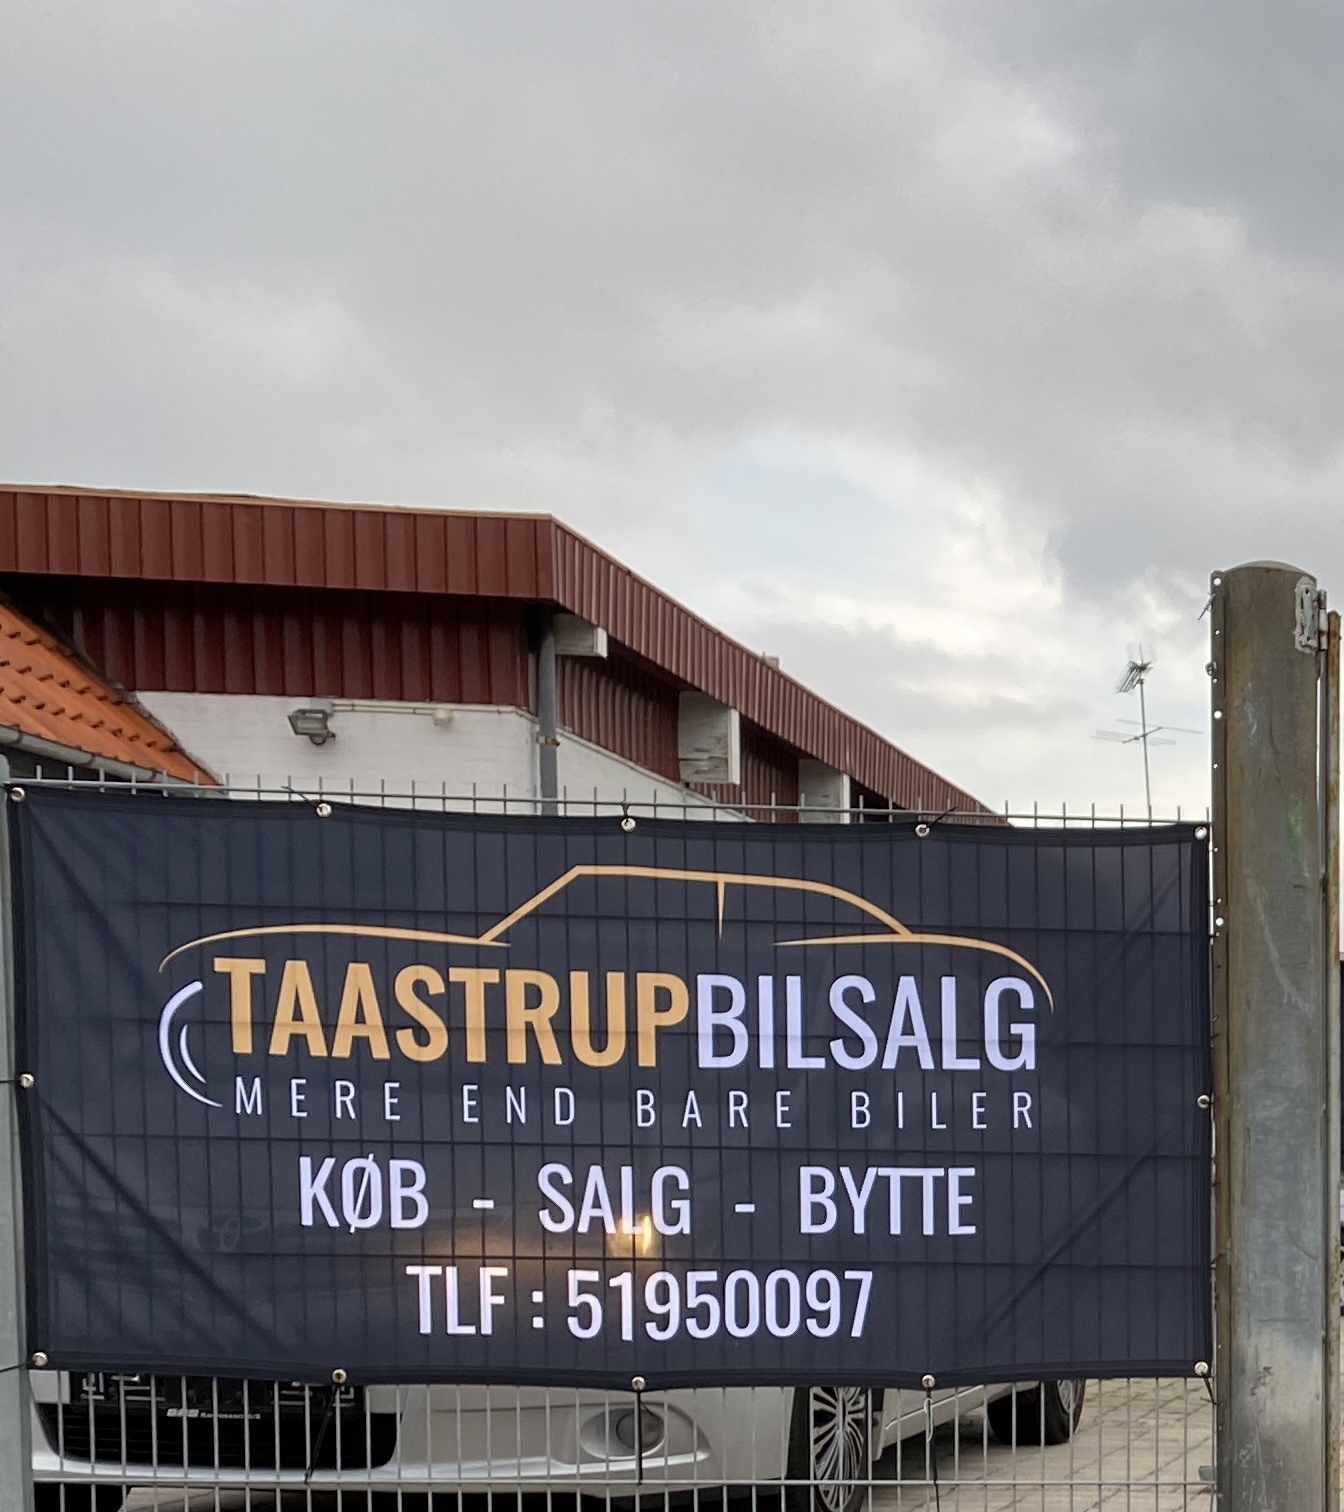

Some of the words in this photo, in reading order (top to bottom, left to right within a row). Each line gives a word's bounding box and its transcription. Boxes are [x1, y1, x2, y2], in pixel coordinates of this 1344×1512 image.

[213, 956, 1037, 1071] TAASTRUPBILSALG
[235, 1076, 401, 1121] MERE
[462, 1084, 575, 1126] END
[636, 1089, 792, 1128] BARE
[851, 1091, 1033, 1130] BILER
[299, 1153, 429, 1234] KØB
[537, 1163, 691, 1236] SALG
[799, 1166, 977, 1236] BYTTE
[405, 1265, 509, 1335] TLF
[567, 1269, 874, 1342] 51950097
